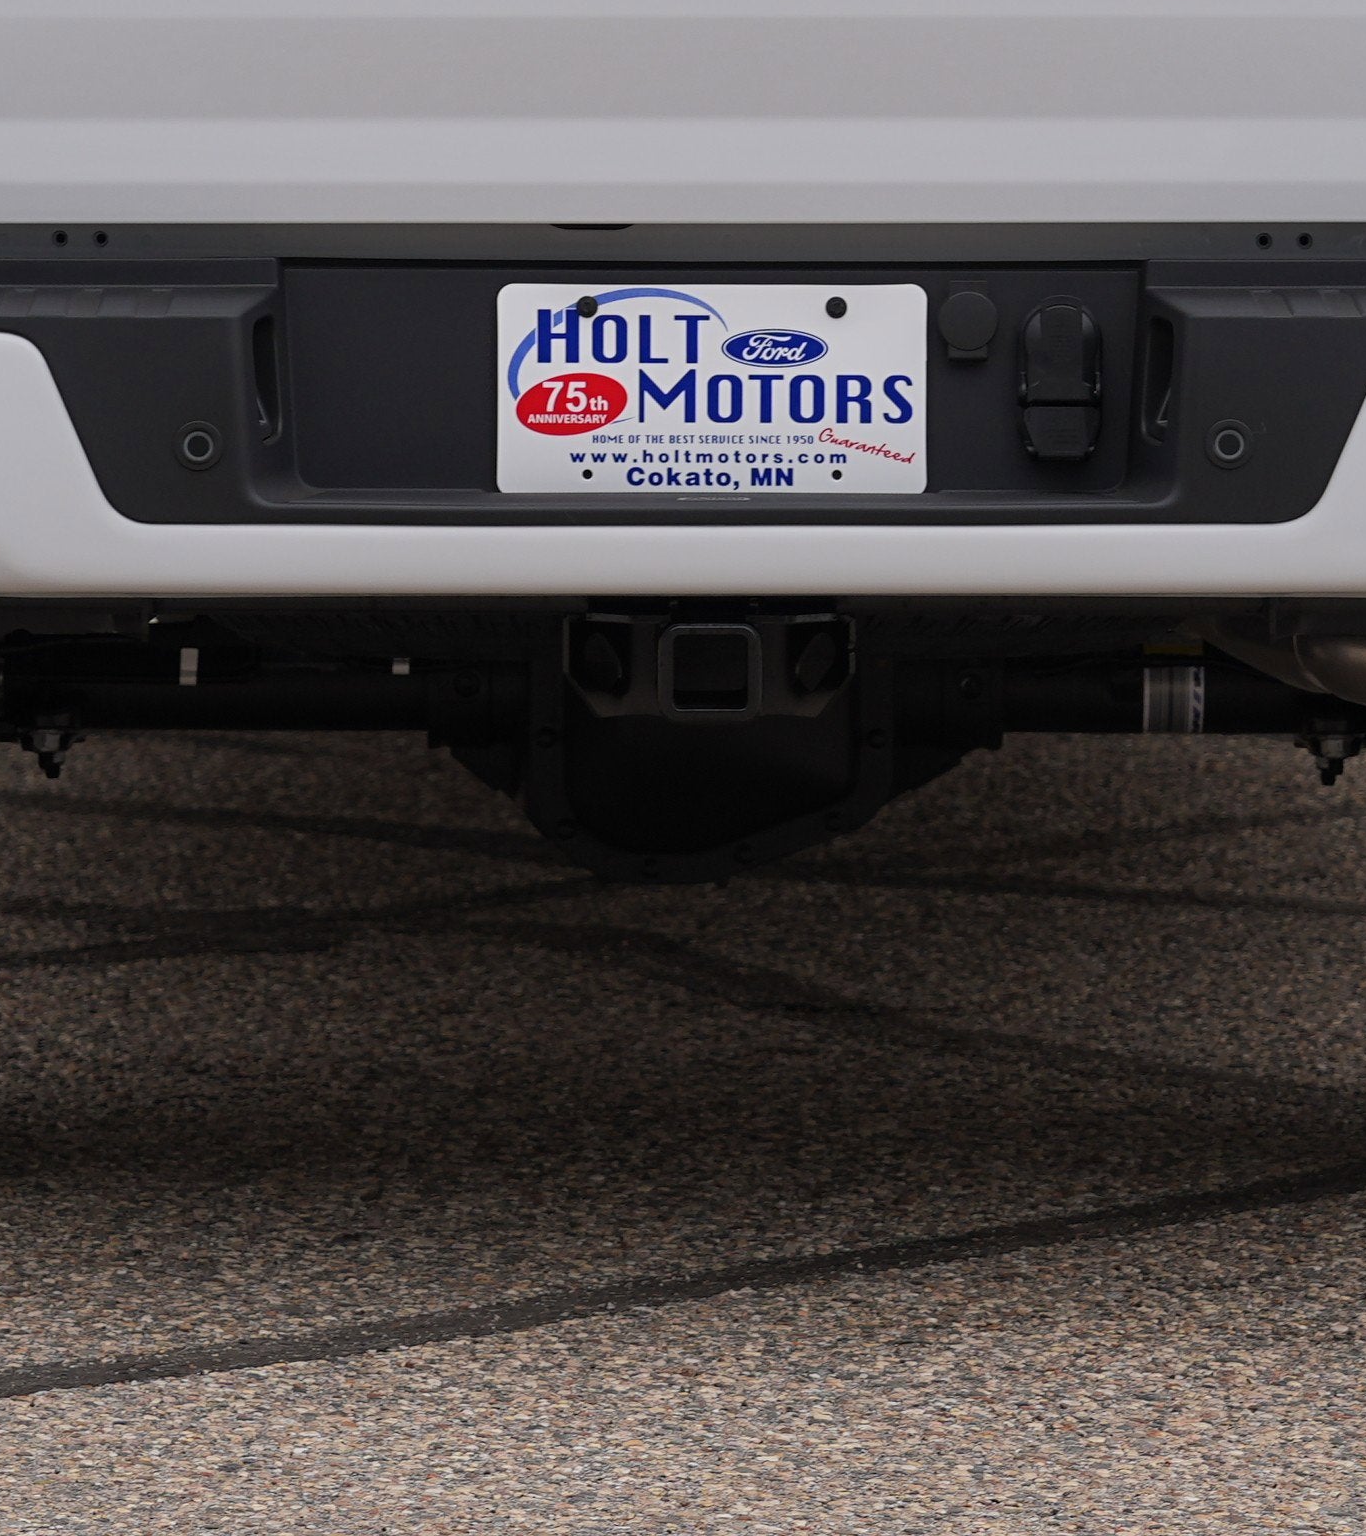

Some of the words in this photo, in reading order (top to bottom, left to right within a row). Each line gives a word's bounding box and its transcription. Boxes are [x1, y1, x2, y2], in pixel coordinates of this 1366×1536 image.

[536, 308, 711, 364] HOLT
[740, 332, 809, 363] Ford
[542, 381, 609, 413] 75th
[638, 368, 914, 424] MOTORS
[527, 413, 608, 425] ANNIVERSARY
[591, 434, 625, 445] HOME
[628, 434, 642, 445] OF
[645, 434, 666, 445] THE
[669, 434, 695, 445] BEST
[698, 434, 744, 445] SERVICE
[748, 434, 783, 445] SINCE
[786, 434, 815, 445] 1950
[818, 427, 916, 465] Guaranteed
[570, 449, 848, 464] www.holtmotors.com
[626, 467, 741, 490] Cokato,
[751, 467, 794, 487] MN
